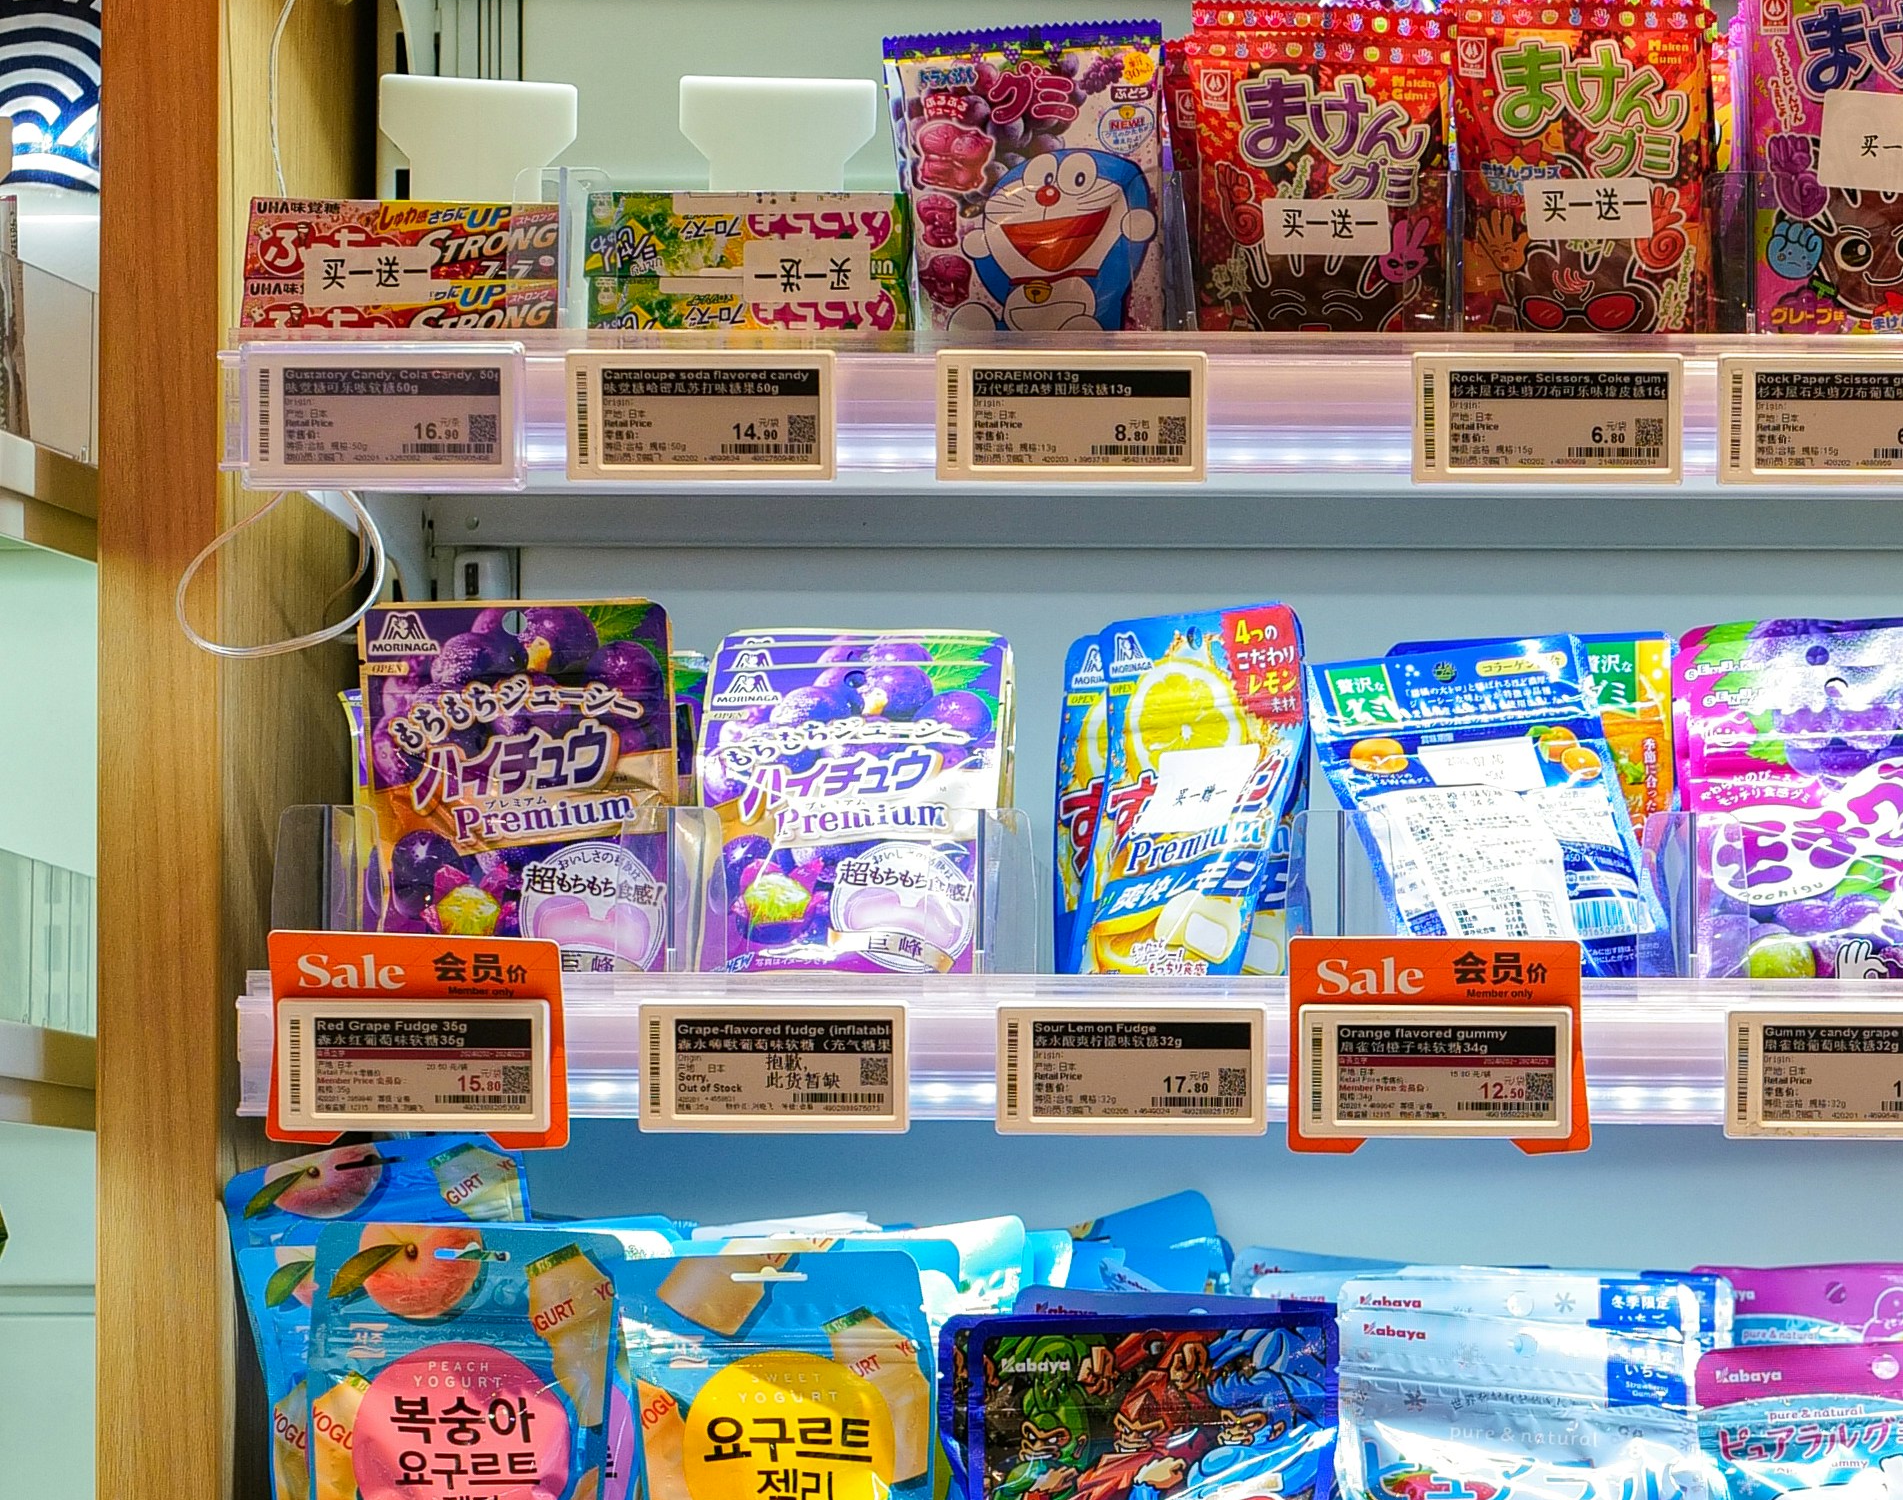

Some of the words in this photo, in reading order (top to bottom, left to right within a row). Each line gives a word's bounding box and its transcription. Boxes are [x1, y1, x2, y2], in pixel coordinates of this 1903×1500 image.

[988, 65, 1079, 124] グミ
[1495, 39, 1687, 136] まけん
[1542, 187, 1639, 223] 买一送一
[1281, 208, 1378, 239] 买一送一
[424, 223, 560, 259] STRONG
[321, 255, 431, 290] 买一送一
[754, 257, 853, 291] 买一送一
[604, 370, 677, 382] Cantaloupe
[679, 370, 710, 380] soda
[713, 370, 767, 380] flavored
[770, 370, 810, 382] candy
[974, 371, 1055, 381] DORAEMON
[1058, 371, 1079, 383] 13g
[371, 641, 439, 654] MORINAGA
[372, 663, 404, 674] OPEN
[389, 678, 642, 751] もちもちジューシー
[416, 725, 620, 809] ハイチュウ
[456, 792, 633, 842] Premium
[299, 955, 406, 991] Sale
[432, 952, 528, 986] 会员价
[1317, 958, 1425, 996] Sale
[1453, 951, 1548, 987] 会员价
[448, 986, 488, 997] Member
[491, 986, 514, 998] only
[316, 1020, 345, 1031] Red
[348, 1020, 390, 1034] Grape
[394, 1020, 438, 1034] Fudge
[441, 1020, 467, 1034] 35g
[457, 1075, 501, 1092] 15.80
[764, 1072, 841, 1090] 此货暂缺
[1479, 1081, 1524, 1099] 12.50
[413, 1375, 502, 1389] YOGURT
[428, 1361, 489, 1372] PEACH
[1001, 1358, 1070, 1374] Kabaya
[391, 1398, 532, 1444] 복숭아
[395, 1451, 540, 1488] 요구르트
